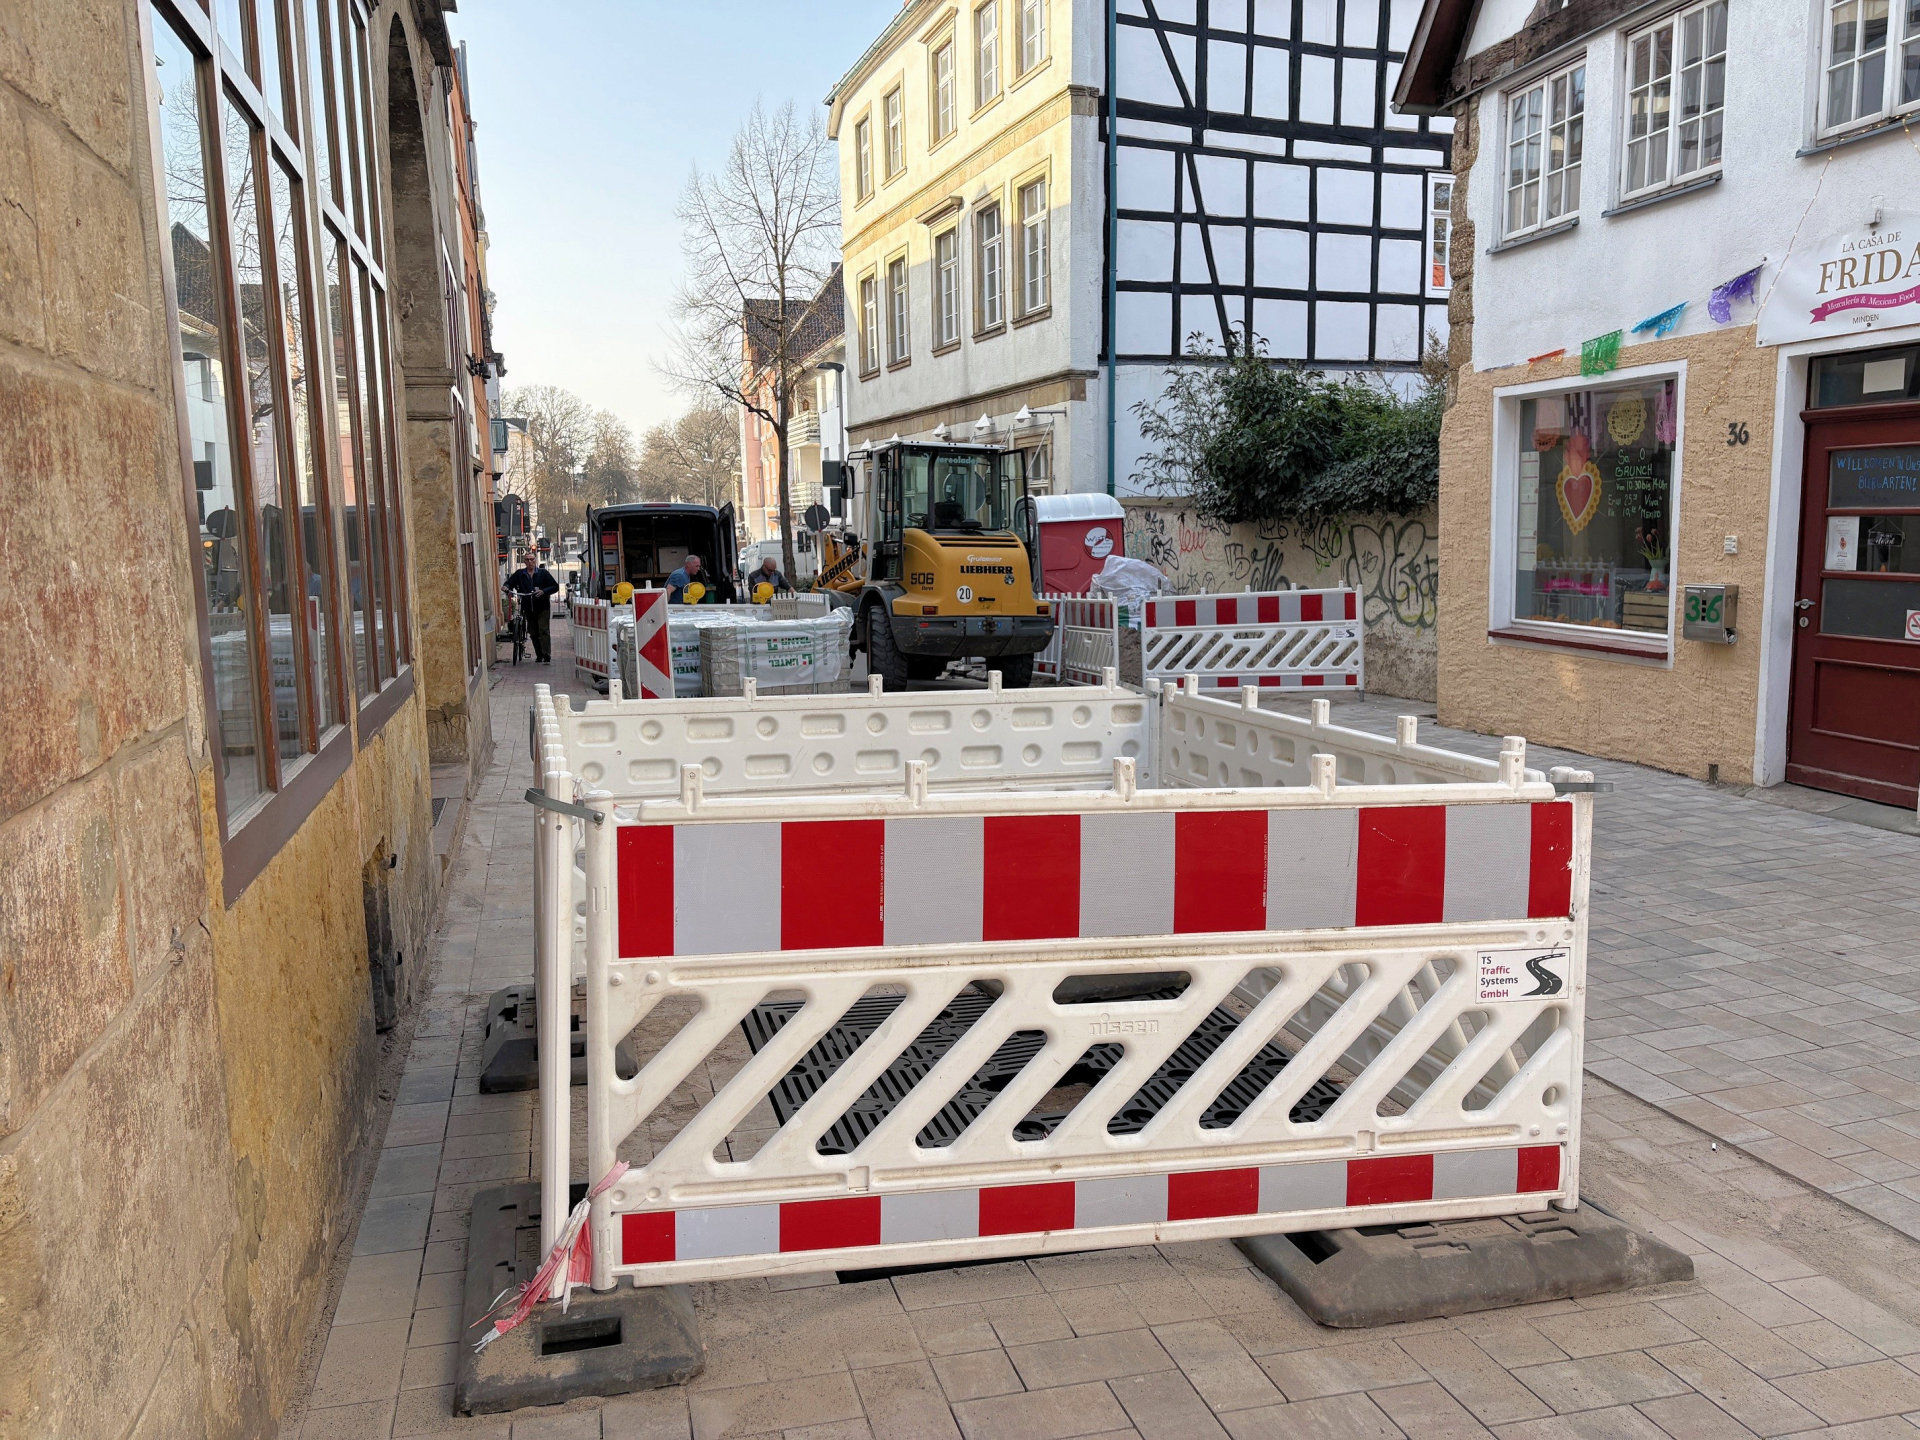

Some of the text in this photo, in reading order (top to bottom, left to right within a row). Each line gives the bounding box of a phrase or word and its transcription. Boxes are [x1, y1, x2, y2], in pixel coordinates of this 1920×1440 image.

[1842, 231, 1902, 253] LA CASA DE
[1868, 296, 1897, 306] Mexican
[1898, 290, 1915, 302] Food
[1852, 313, 1879, 325] MINDEN
[1726, 421, 1749, 446] 36
[817, 548, 860, 588] LIEBHERR
[960, 565, 1013, 574] LIEBHERR
[910, 572, 934, 585] 506
[959, 588, 971, 600] 20
[1481, 956, 1492, 964] TS
[1481, 966, 1510, 975] Traffic
[1480, 976, 1519, 987] Systems
[1480, 989, 1509, 998] GmbH
[1089, 1012, 1160, 1034] nissen
